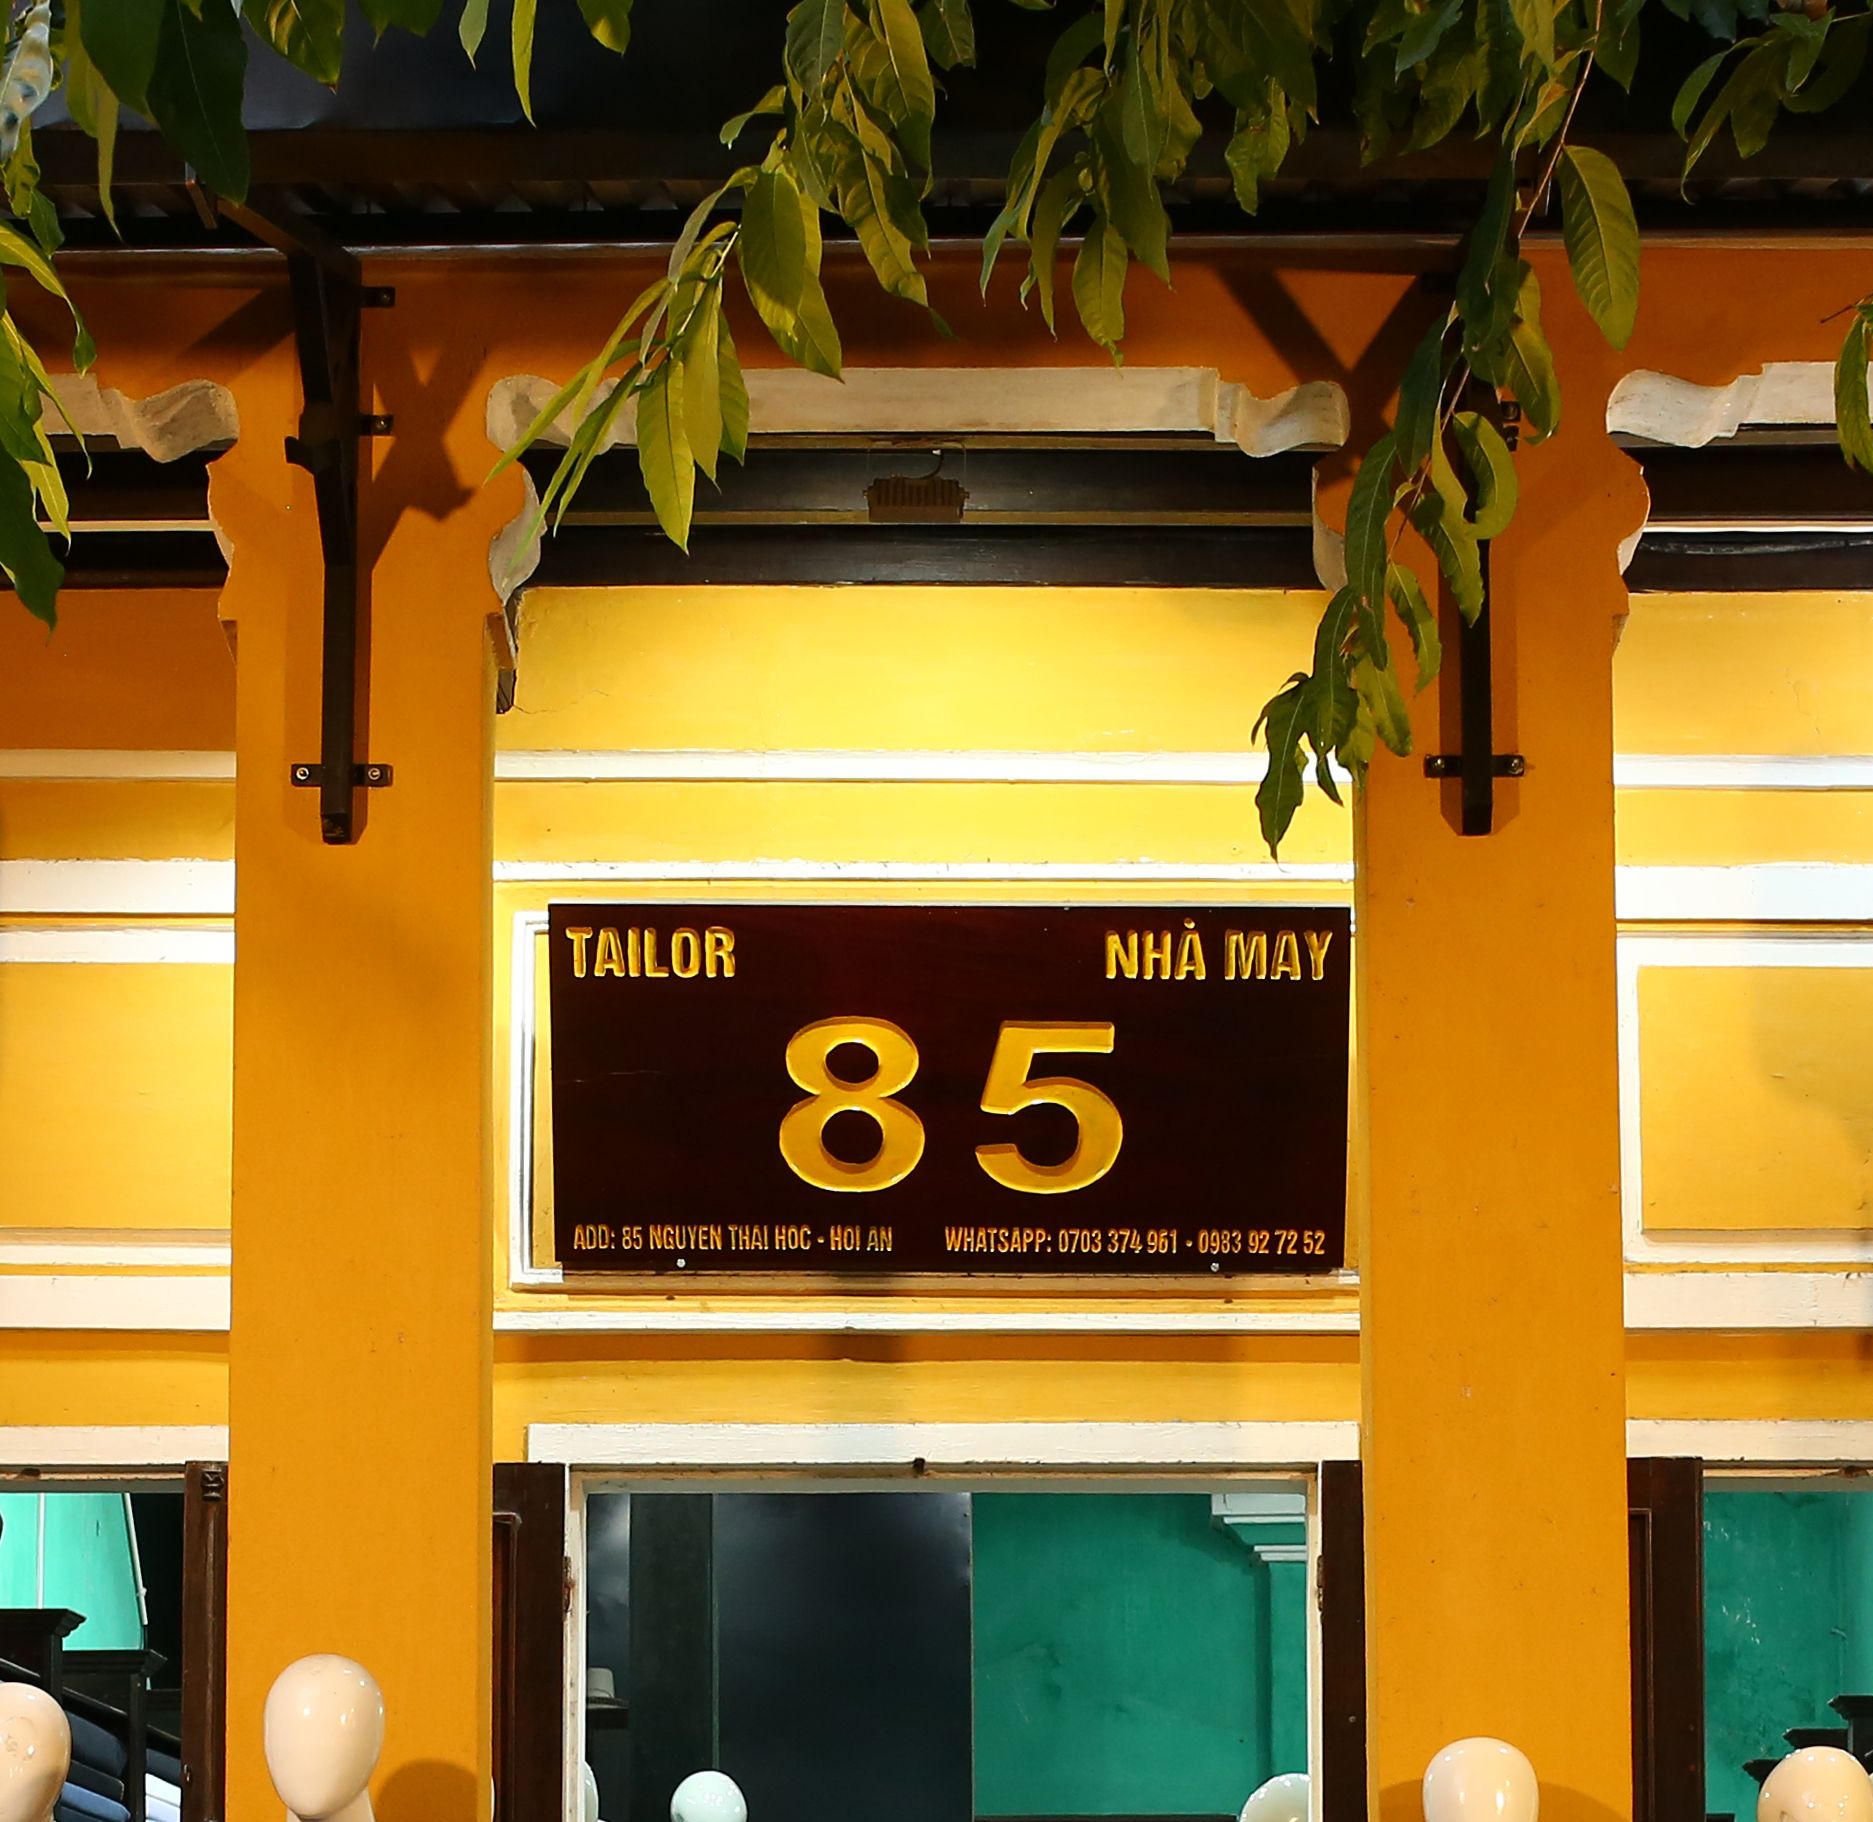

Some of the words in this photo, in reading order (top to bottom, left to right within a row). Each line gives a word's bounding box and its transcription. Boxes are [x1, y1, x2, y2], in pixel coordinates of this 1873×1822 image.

[565, 926, 736, 978] TAILOR
[1105, 917, 1206, 980] NHÀ
[1224, 929, 1334, 980] MAY
[573, 1224, 616, 1250] ADD:
[622, 1226, 642, 1250] 85
[649, 1224, 722, 1251] NGUYEN
[728, 1224, 769, 1251] THAI
[775, 1224, 811, 1251] HOC
[830, 1225, 860, 1252] HOI
[866, 1226, 893, 1253] AN
[944, 1226, 1052, 1253] WHATSAPP:
[1058, 1228, 1102, 1254] 0703
[1107, 1228, 1143, 1255] 374
[1147, 1229, 1177, 1254] 961
[1198, 1229, 1242, 1255] 0983
[1247, 1229, 1270, 1254] 92
[1274, 1229, 1298, 1255] 72
[1303, 1229, 1326, 1255] 52
